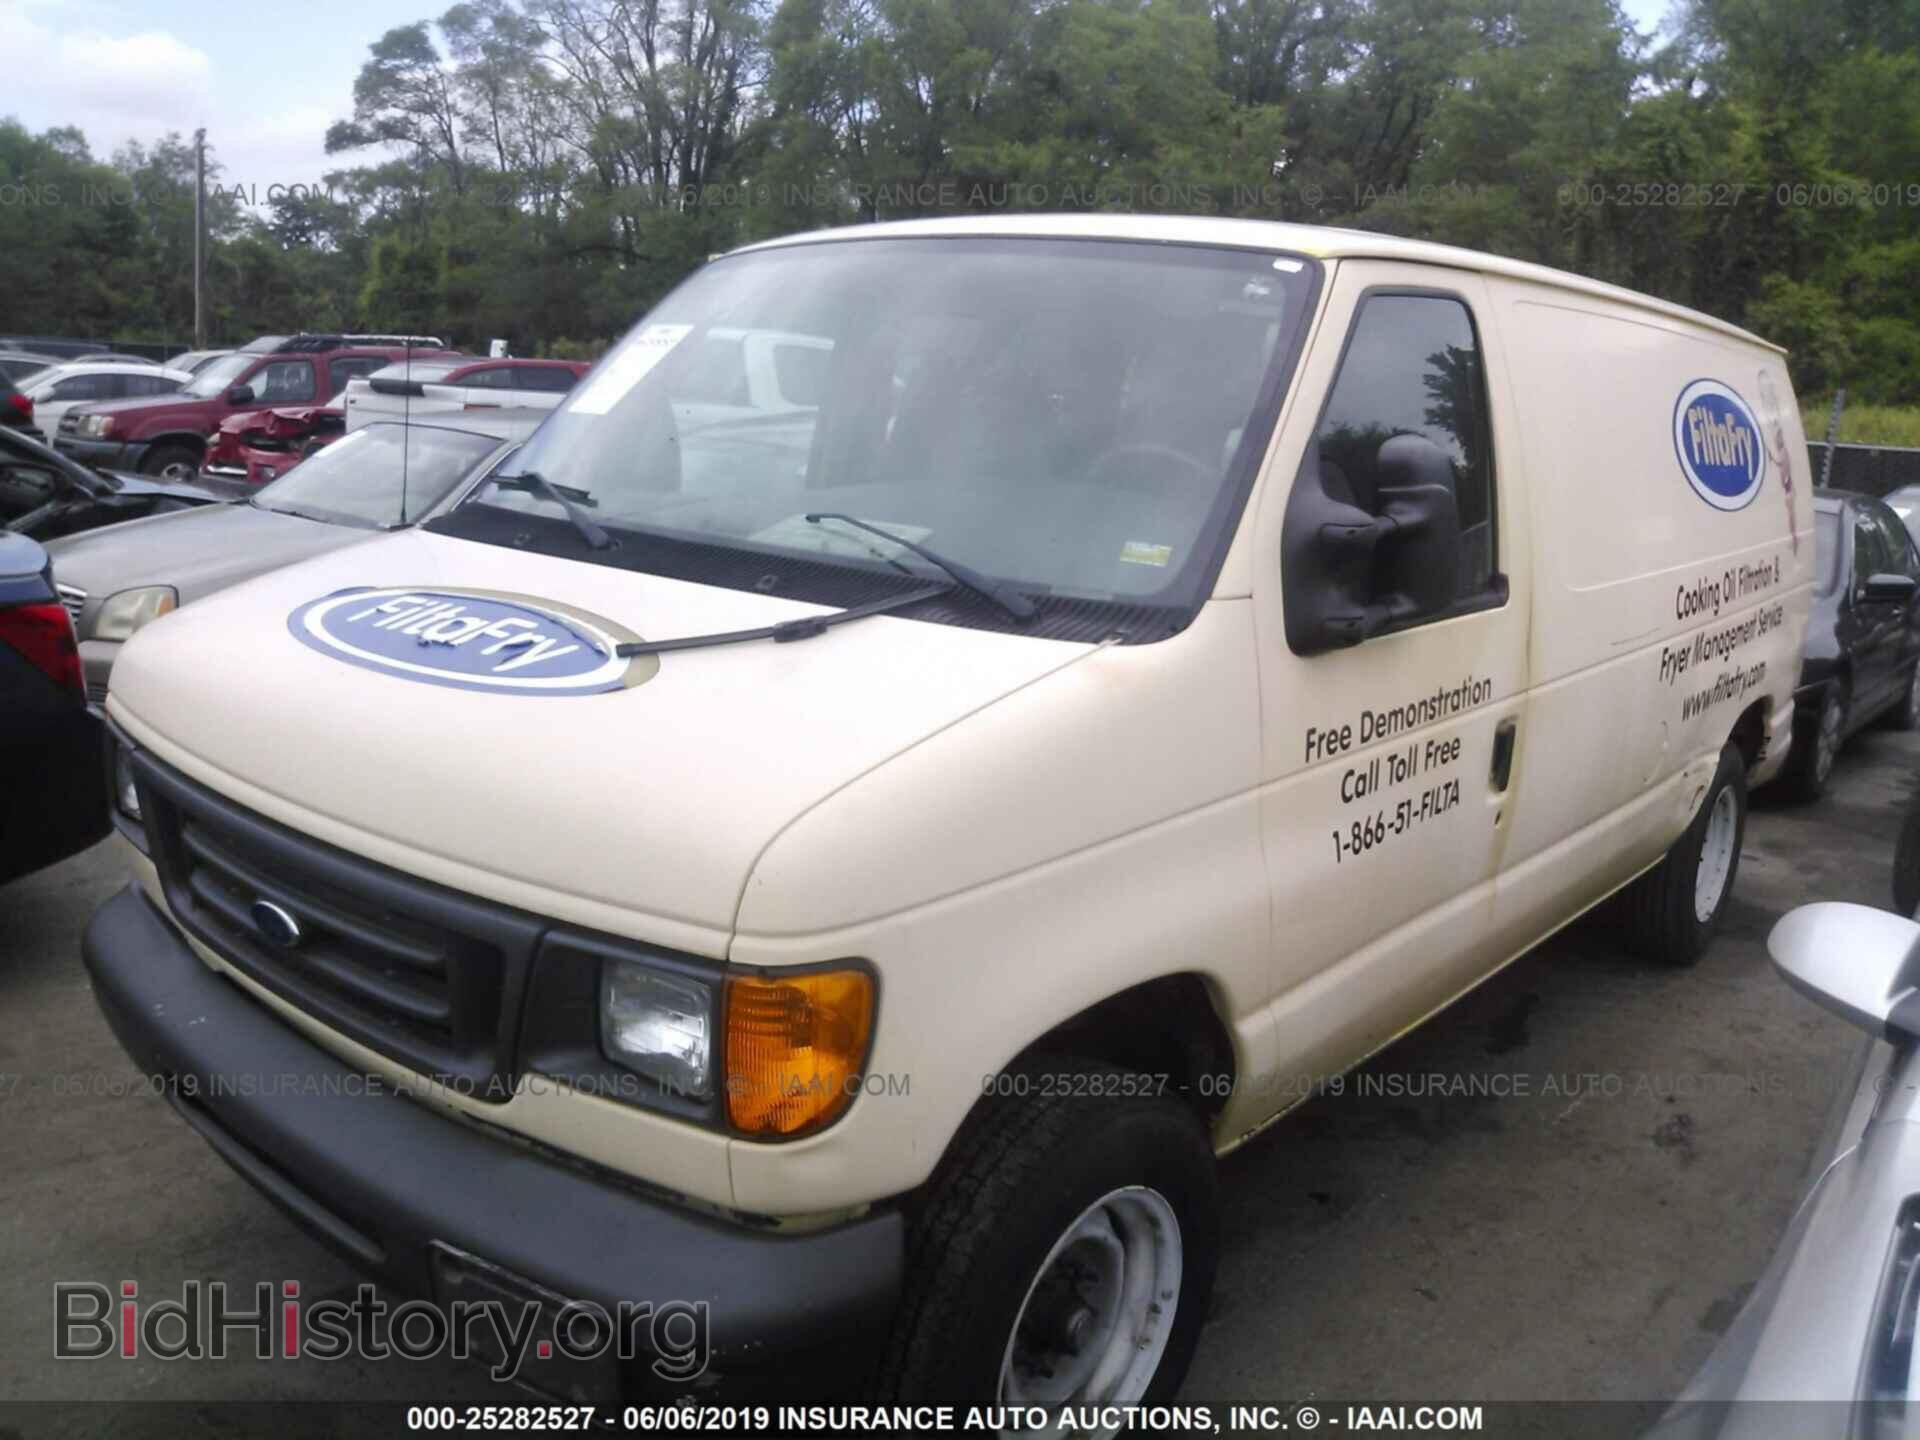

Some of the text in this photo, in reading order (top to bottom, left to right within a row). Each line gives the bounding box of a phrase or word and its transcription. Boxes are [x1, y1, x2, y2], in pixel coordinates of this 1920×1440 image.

[1687, 405, 1753, 481] FiltaFry
[1676, 576, 1720, 622] Cooking
[1723, 567, 1736, 604] Oil
[346, 596, 580, 673] FiltaFry
[1659, 603, 1783, 686] Fryer Management Service
[1305, 674, 1493, 764] Free Demonstration
[1341, 737, 1462, 805] Call Toll Free
[1332, 777, 1461, 864] 1-866-51-FILTA
